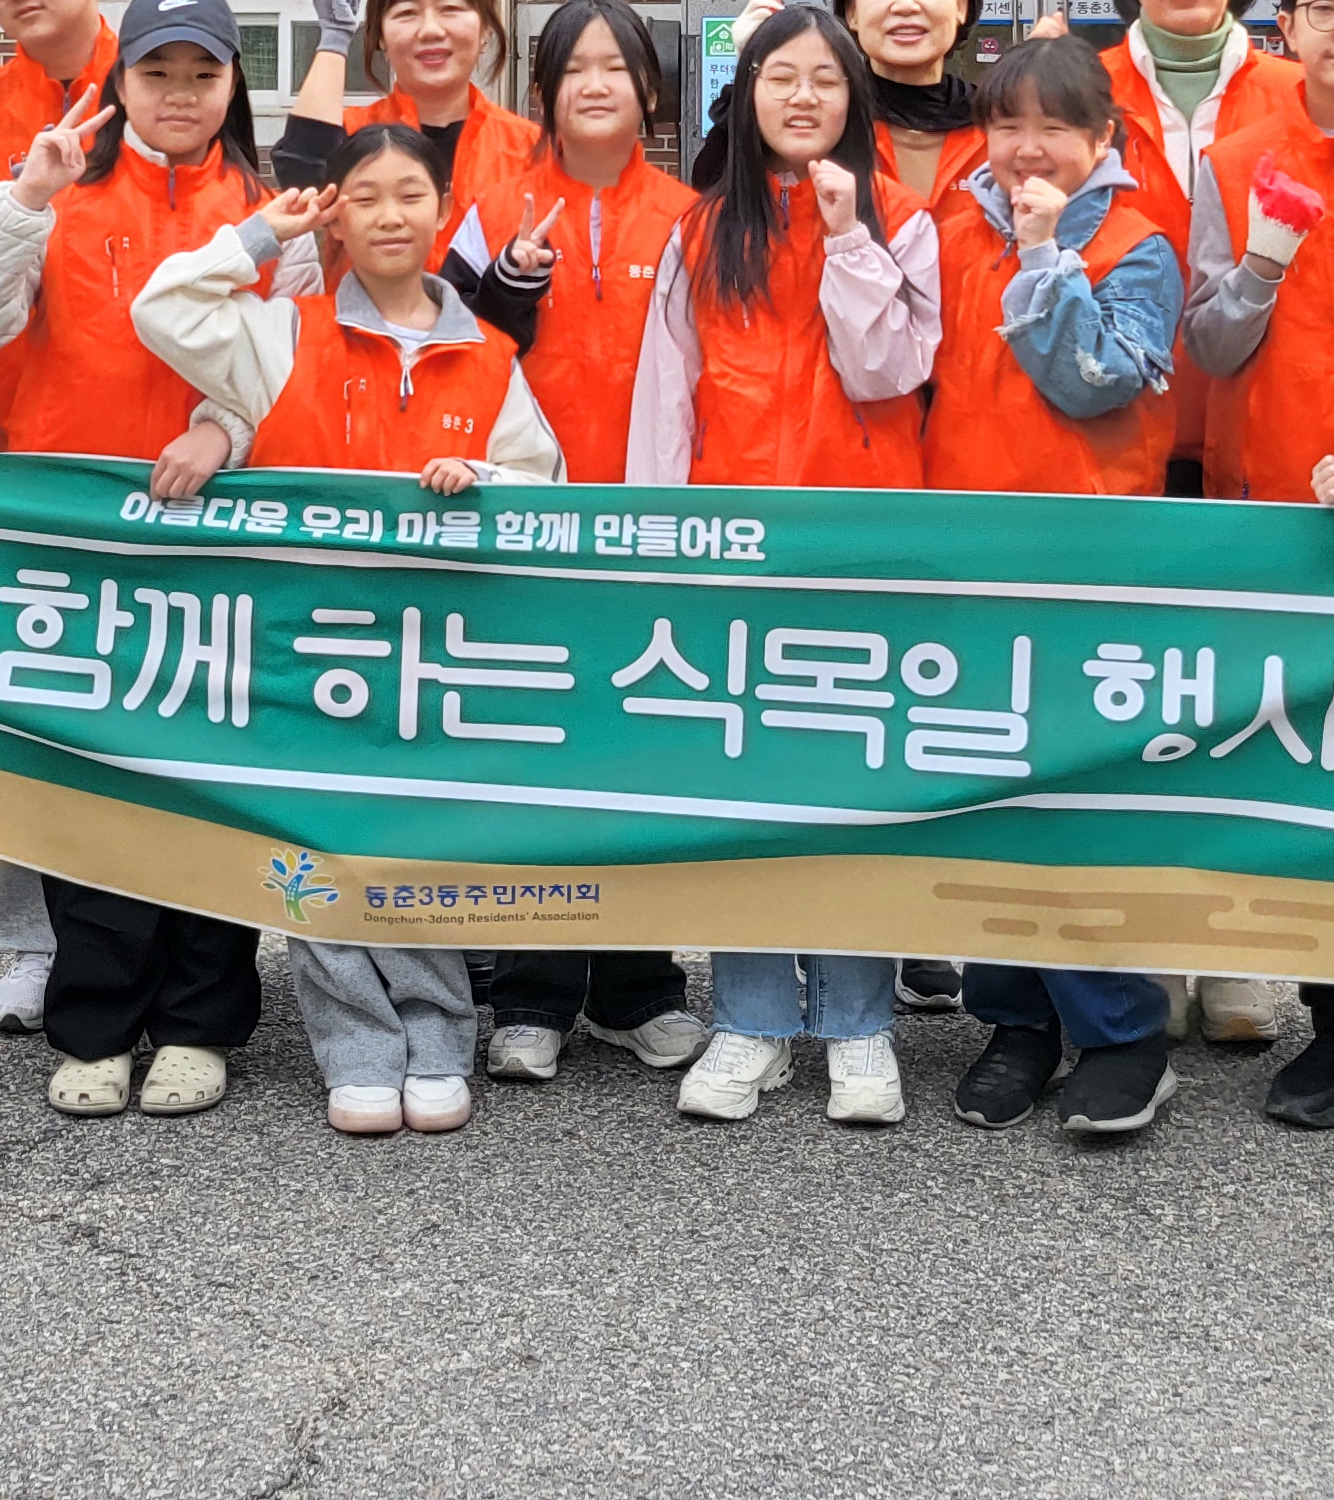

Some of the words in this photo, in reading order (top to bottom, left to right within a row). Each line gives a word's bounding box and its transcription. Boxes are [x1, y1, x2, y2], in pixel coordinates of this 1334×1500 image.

[119, 491, 289, 535] 아름다운
[299, 505, 384, 543] 우리
[397, 510, 481, 548] 마을
[495, 510, 580, 553] 함께
[594, 513, 765, 561] 만들어요
[293, 607, 575, 745] 하는
[610, 617, 1032, 778] 식목일
[362, 882, 601, 909] 동춘3동주민자치회
[364, 912, 465, 926] Dongchun-3dong
[532, 910, 600, 922] Association
